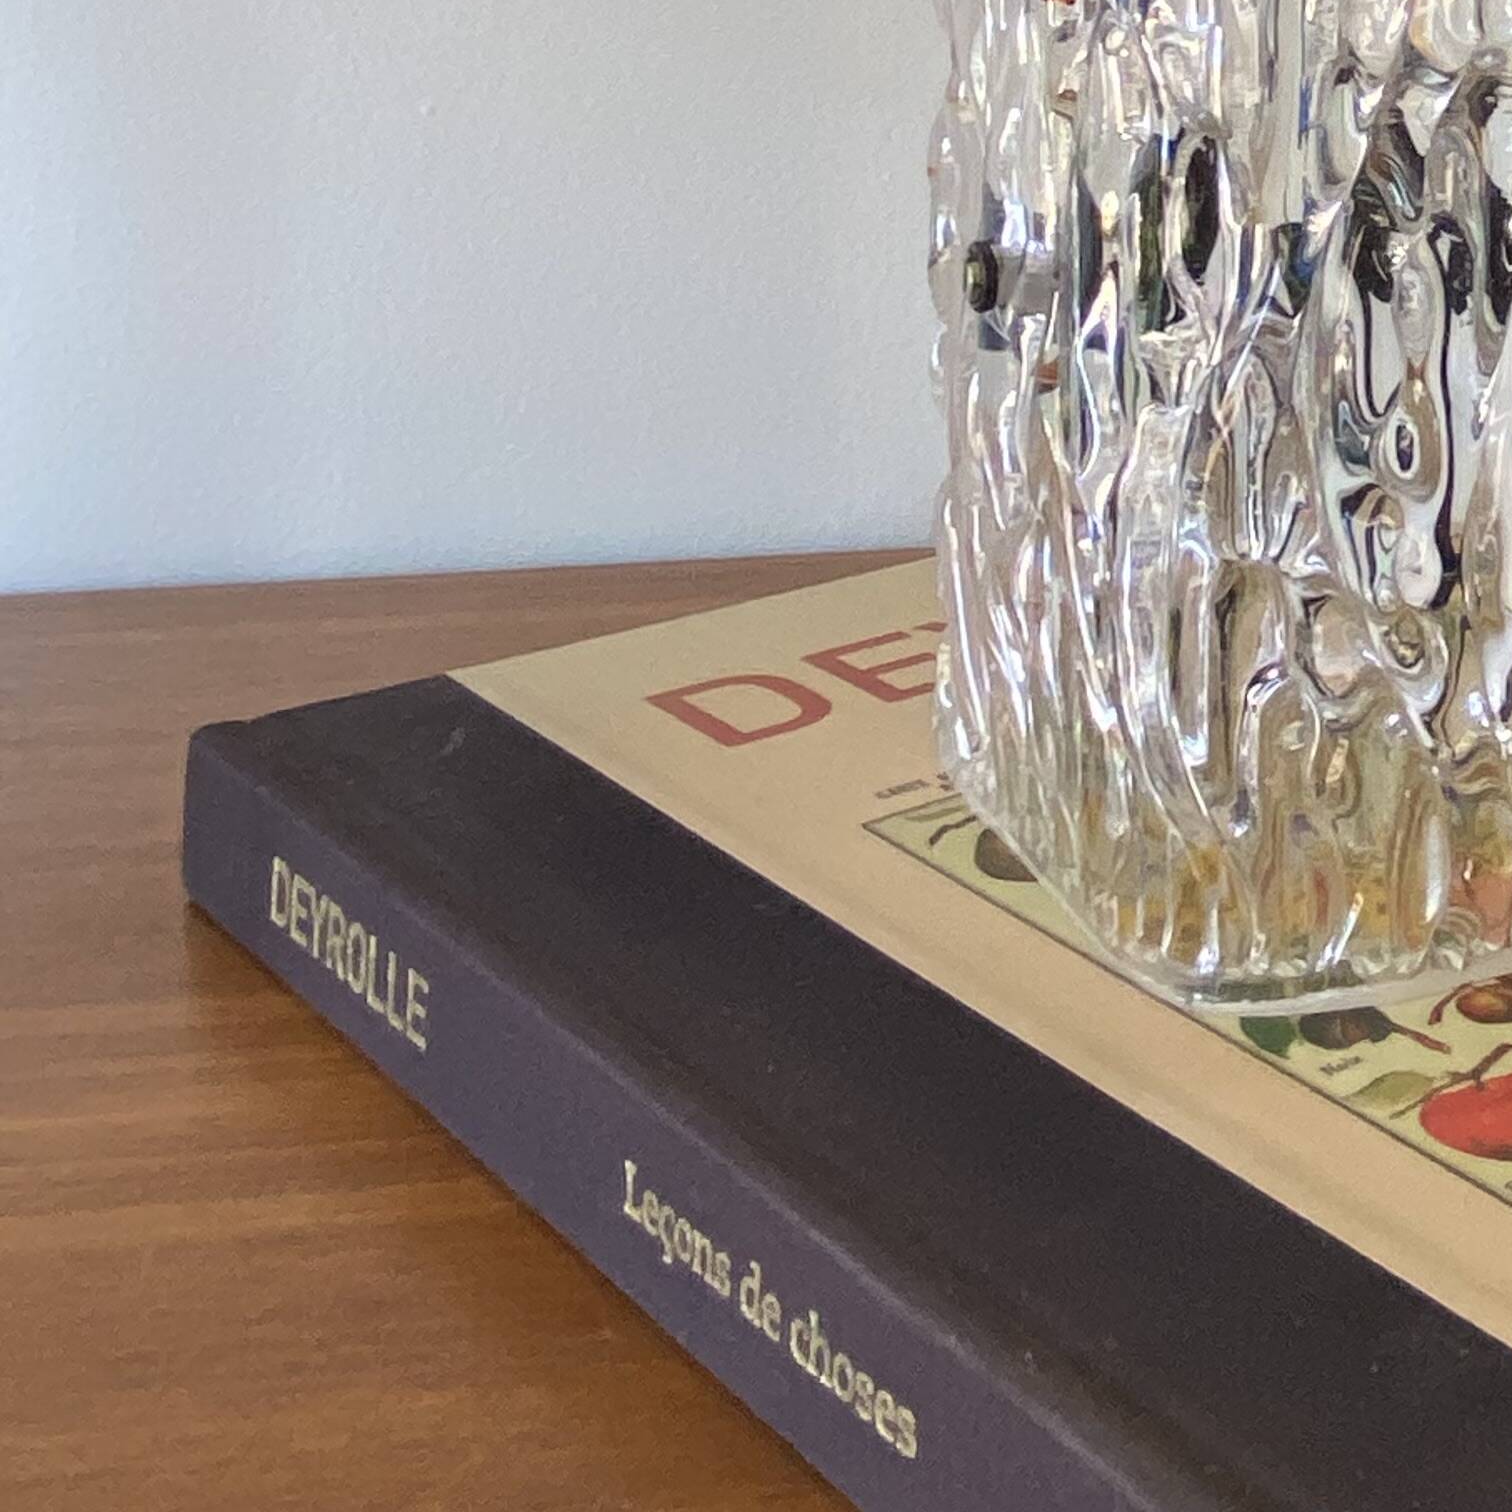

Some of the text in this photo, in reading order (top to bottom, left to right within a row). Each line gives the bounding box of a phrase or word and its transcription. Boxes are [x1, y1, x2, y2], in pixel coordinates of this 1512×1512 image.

[646, 621, 948, 747] DE
[270, 857, 430, 1050] DEYROLLE
[623, 1159, 917, 1458] Leçons de choses
